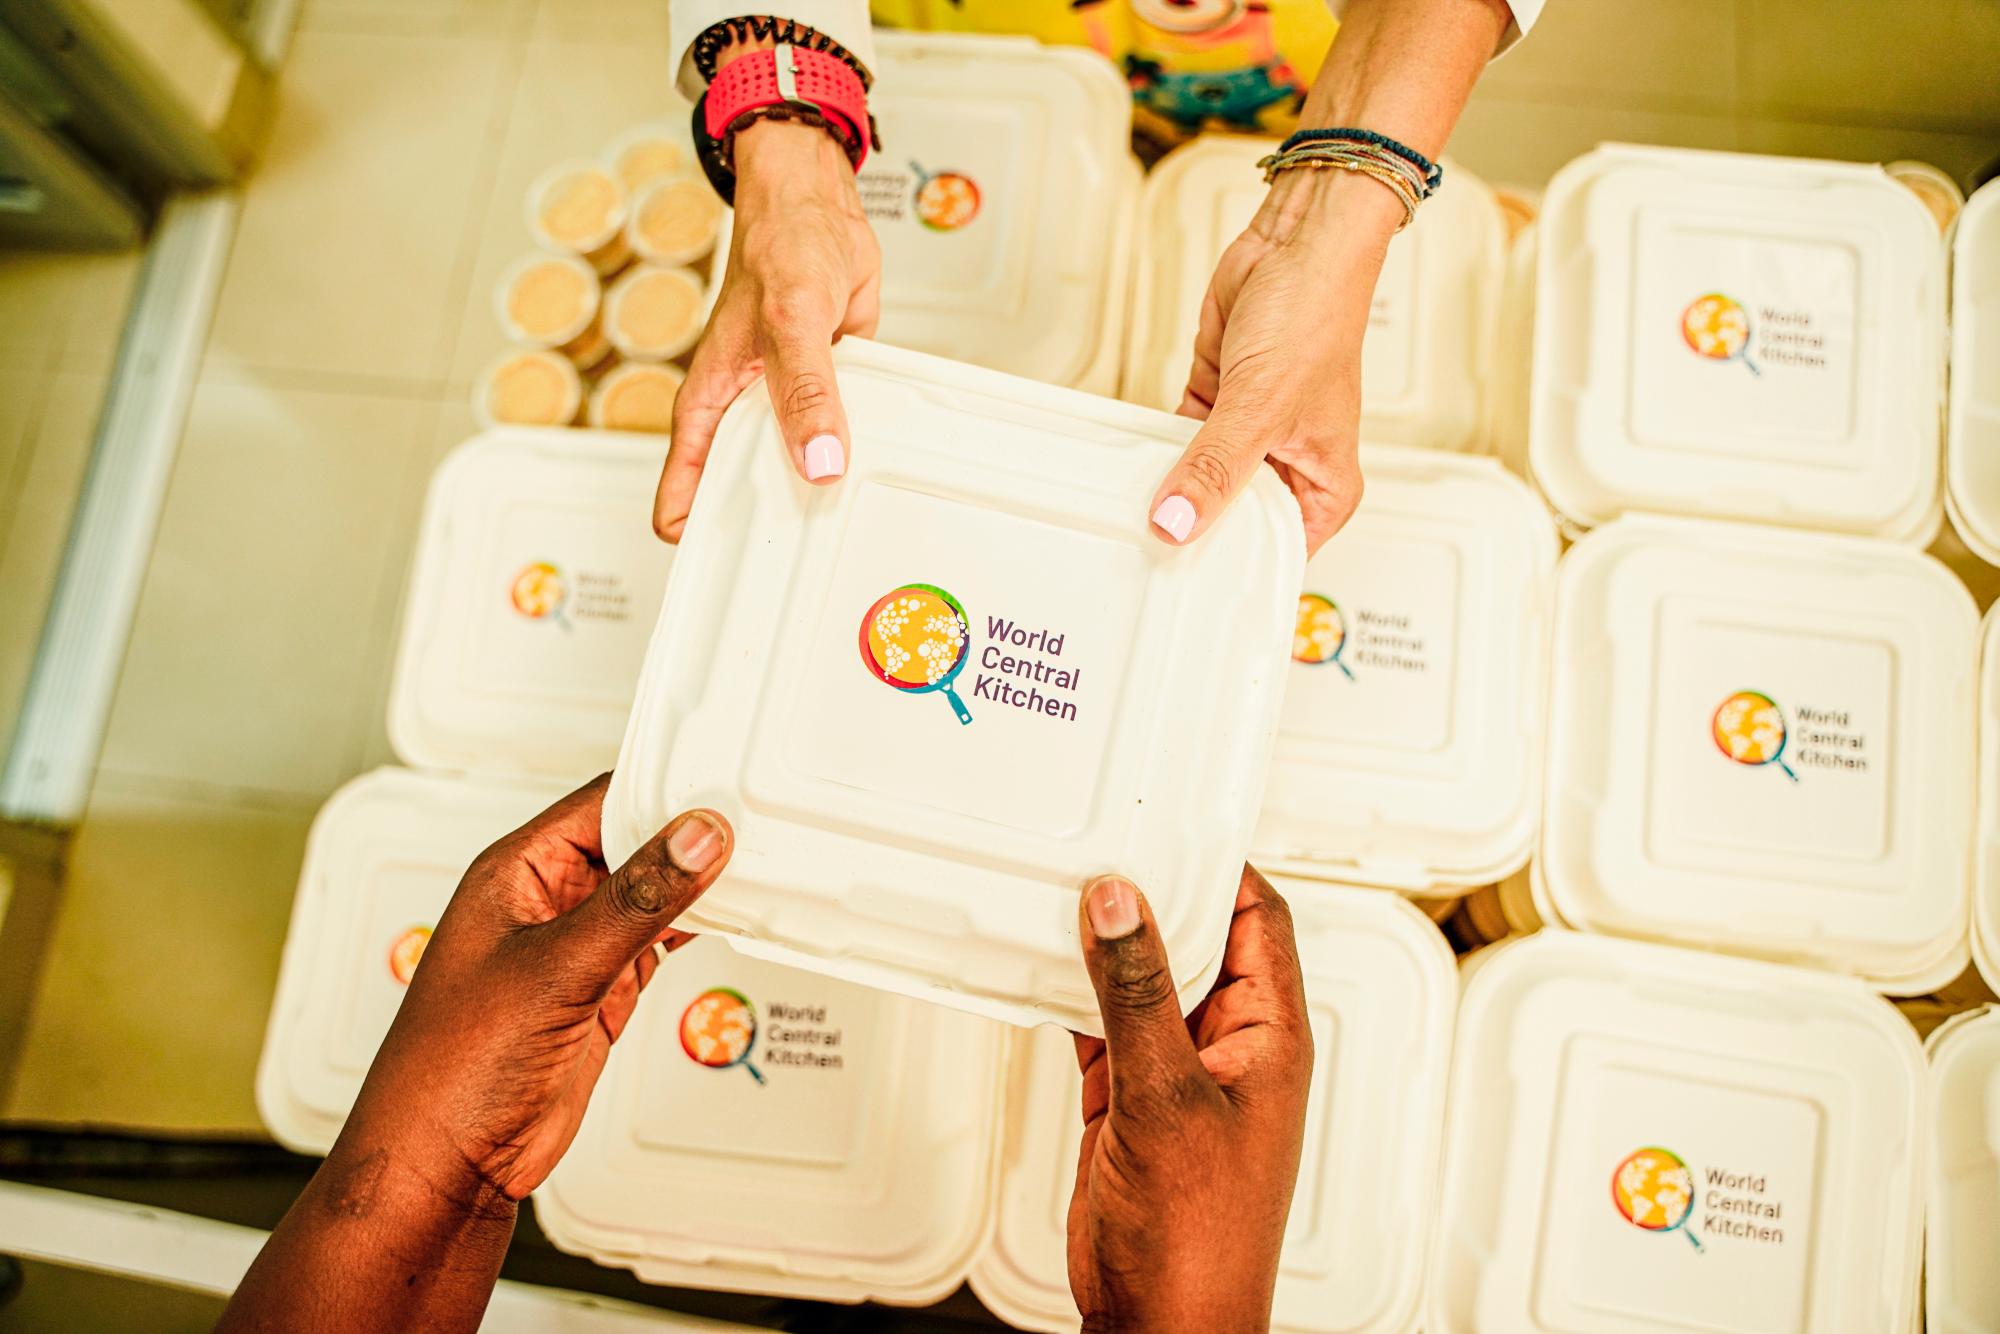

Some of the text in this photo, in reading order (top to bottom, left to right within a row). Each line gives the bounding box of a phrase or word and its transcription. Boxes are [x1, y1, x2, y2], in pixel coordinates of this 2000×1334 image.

[988, 615, 1065, 657] World
[981, 646, 1081, 691] Central
[973, 674, 1077, 721] Kitchen
[1795, 705, 1849, 729] World
[1796, 725, 1864, 752] Central
[1795, 748, 1868, 775] Kitchen
[767, 1002, 827, 1026] World
[767, 1023, 842, 1048] Central
[764, 1046, 844, 1071] Kitchen
[1705, 1167, 1766, 1195] World
[1706, 1189, 1782, 1220] Central
[1704, 1213, 1784, 1245] Kitchen
